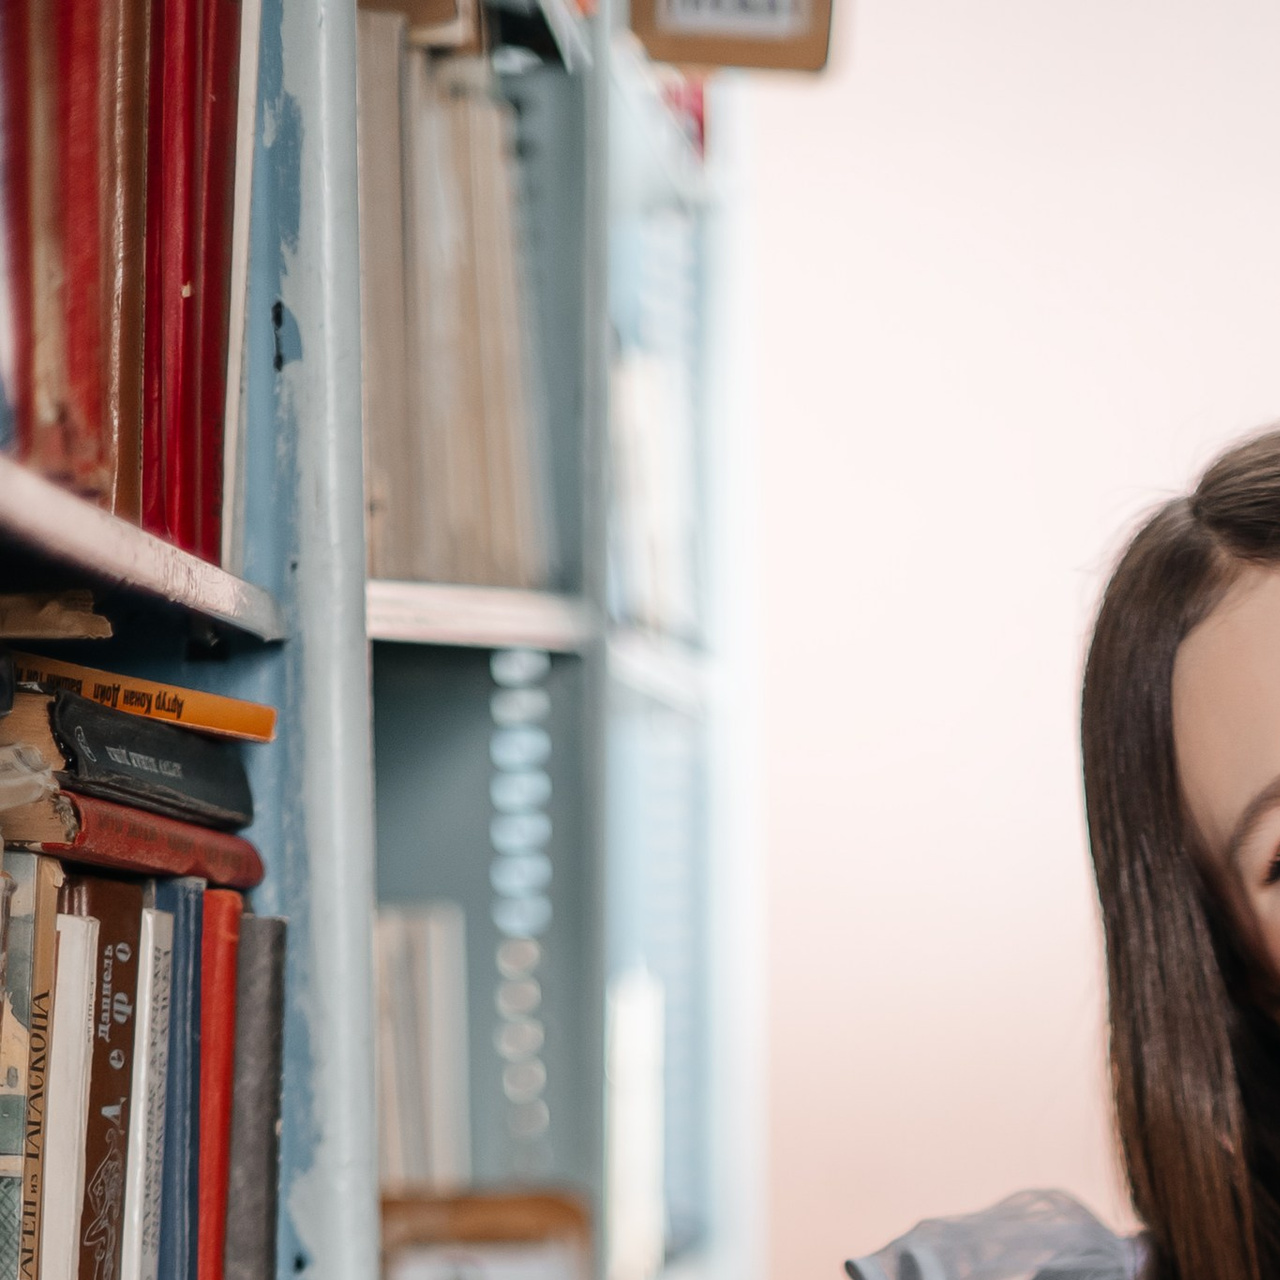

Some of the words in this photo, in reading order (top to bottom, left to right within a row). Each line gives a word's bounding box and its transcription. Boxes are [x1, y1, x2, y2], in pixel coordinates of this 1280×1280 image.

[93, 683, 121, 708] Дойл
[123, 688, 152, 714] Конан
[155, 691, 185, 719] Артур
[26, 989, 50, 1159] ТАРАСКОНА
